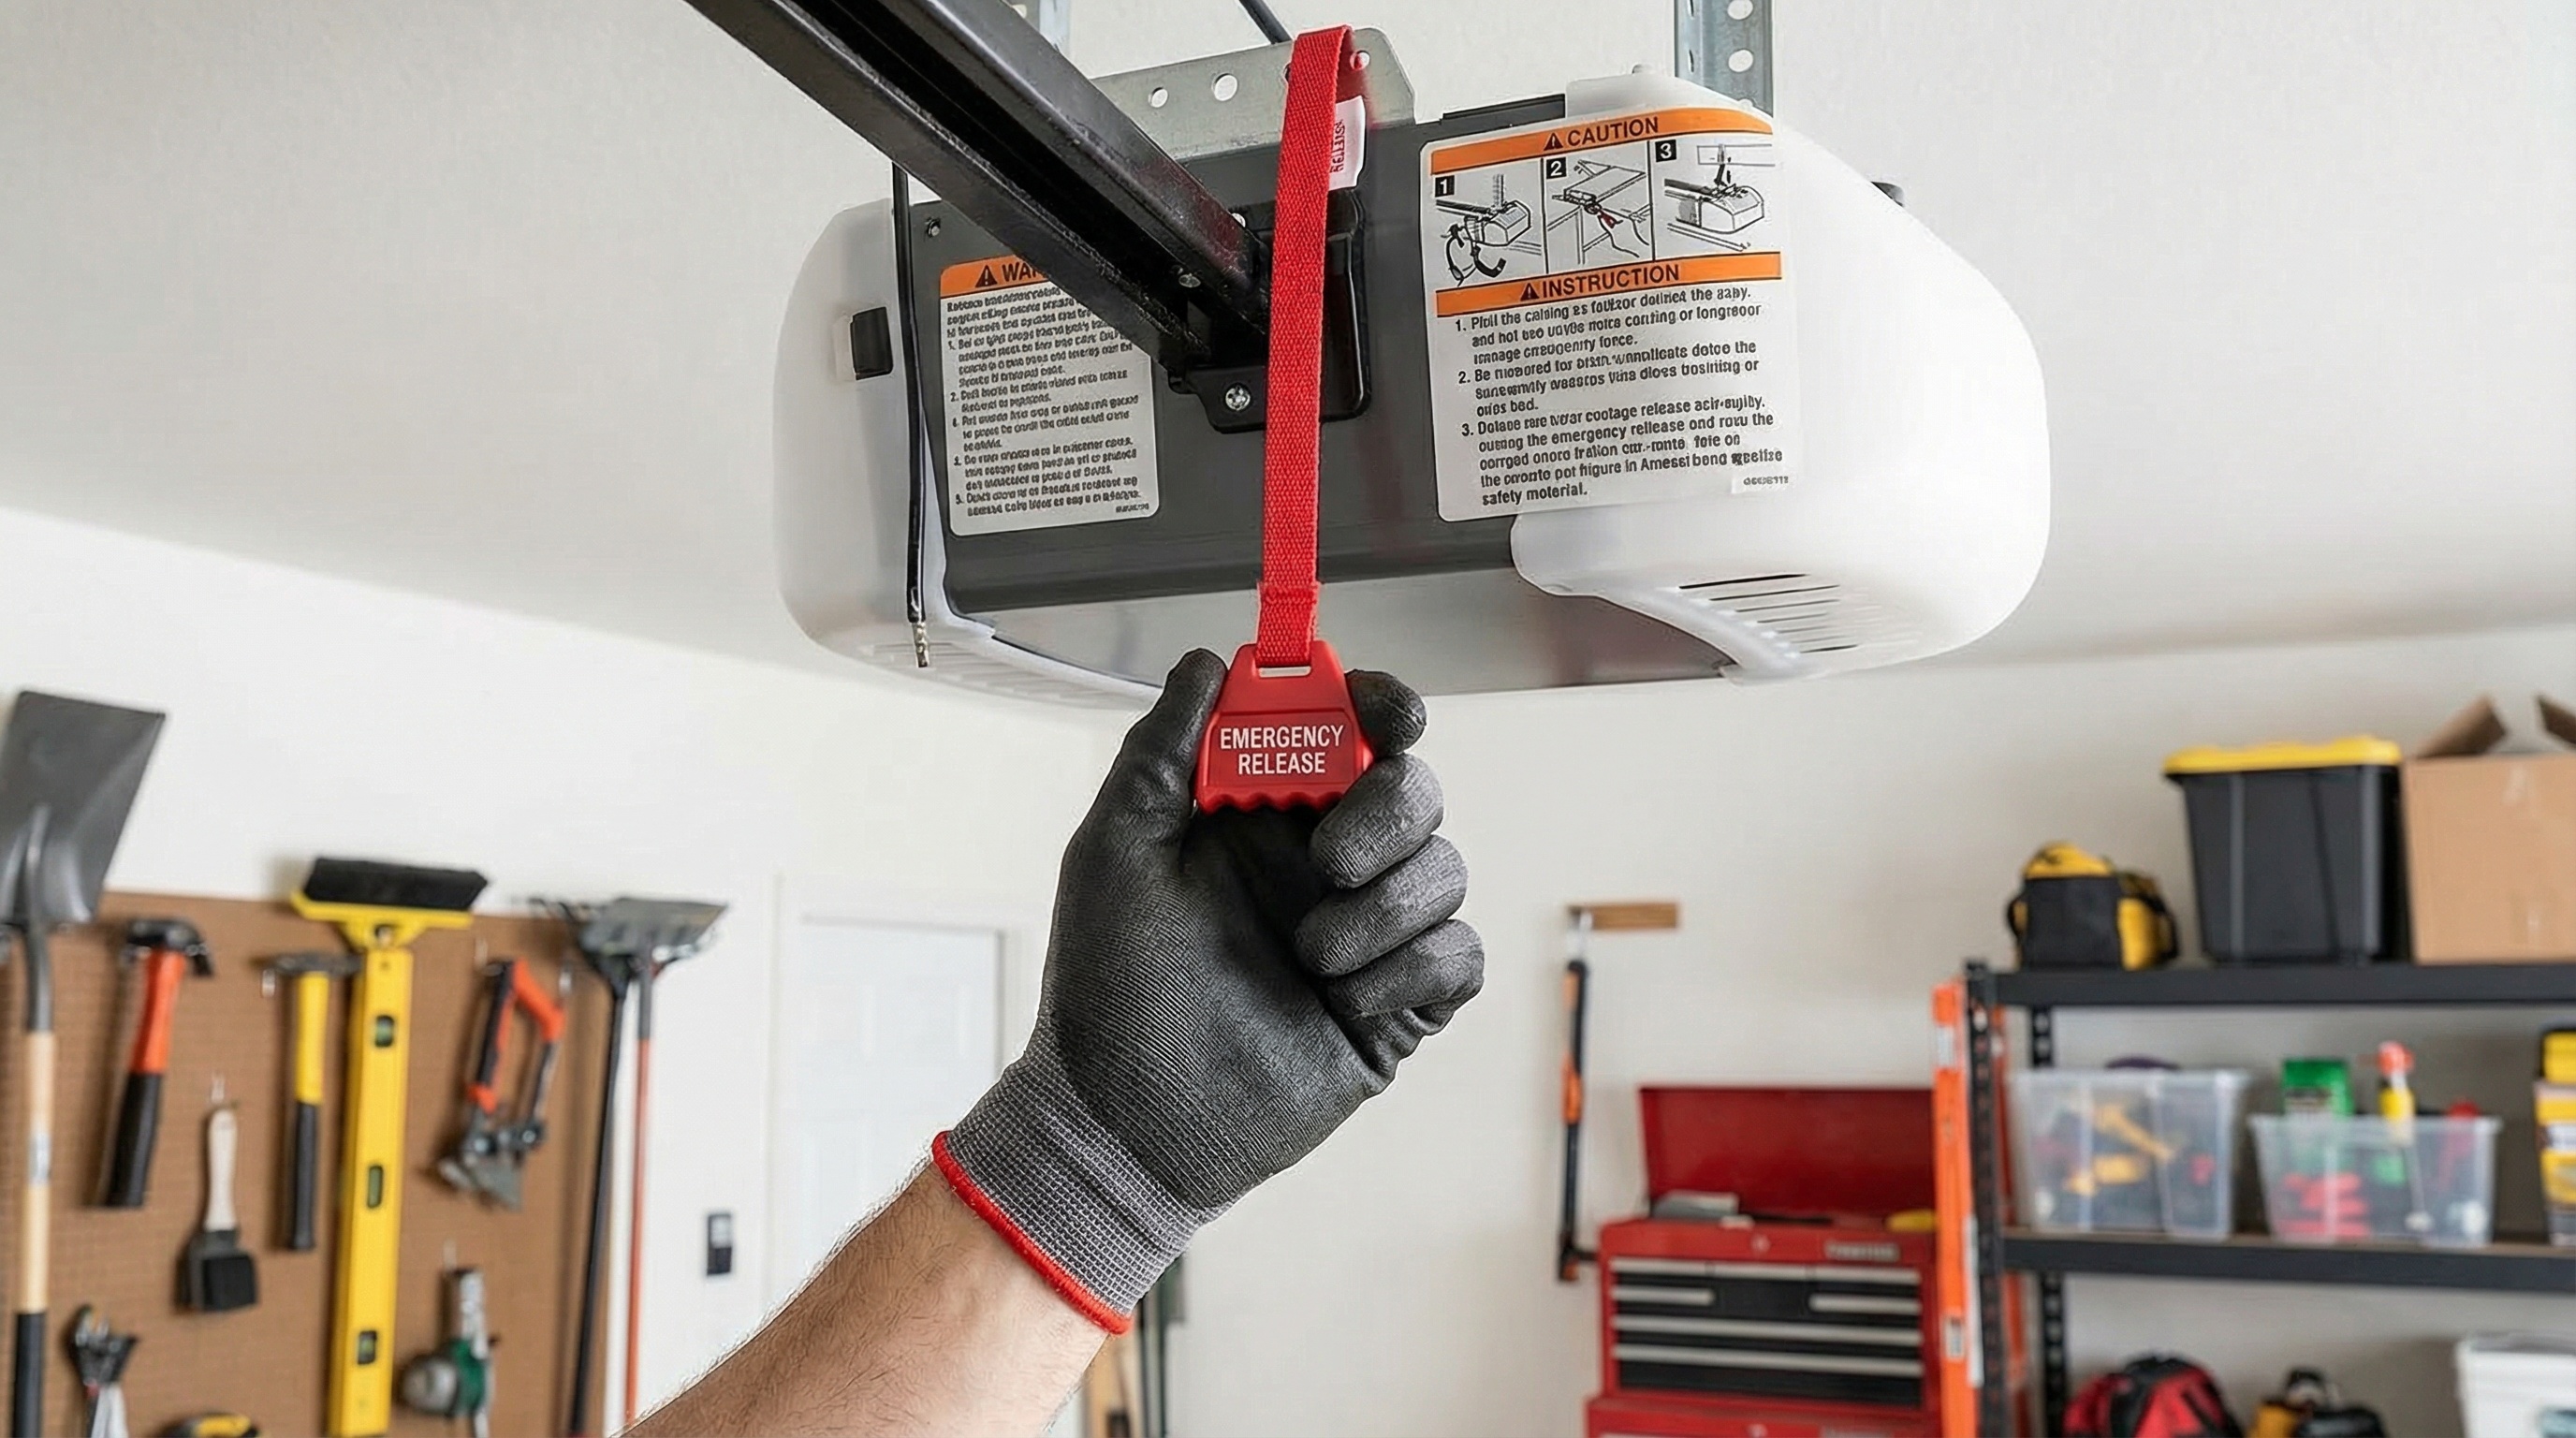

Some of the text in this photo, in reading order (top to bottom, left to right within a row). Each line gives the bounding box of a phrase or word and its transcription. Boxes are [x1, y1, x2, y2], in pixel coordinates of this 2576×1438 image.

[1568, 116, 1659, 148] CAUTION
[1660, 142, 1673, 159] 3
[1550, 161, 1562, 176] 2
[1439, 180, 1449, 195] 1
[1542, 264, 1679, 297] INSTRUCTION
[1456, 319, 1467, 331] 1.
[1690, 288, 1713, 301] the
[1471, 332, 1495, 348] and
[1744, 360, 1760, 372] or
[1457, 371, 1471, 385] 2.
[1474, 369, 1491, 382] Be
[1461, 422, 1474, 437] 3.
[1551, 426, 1627, 444] emergency
[1752, 413, 1774, 426] the
[1220, 725, 1344, 750] EMERGENCY
[1238, 752, 1326, 775] RELEASE
